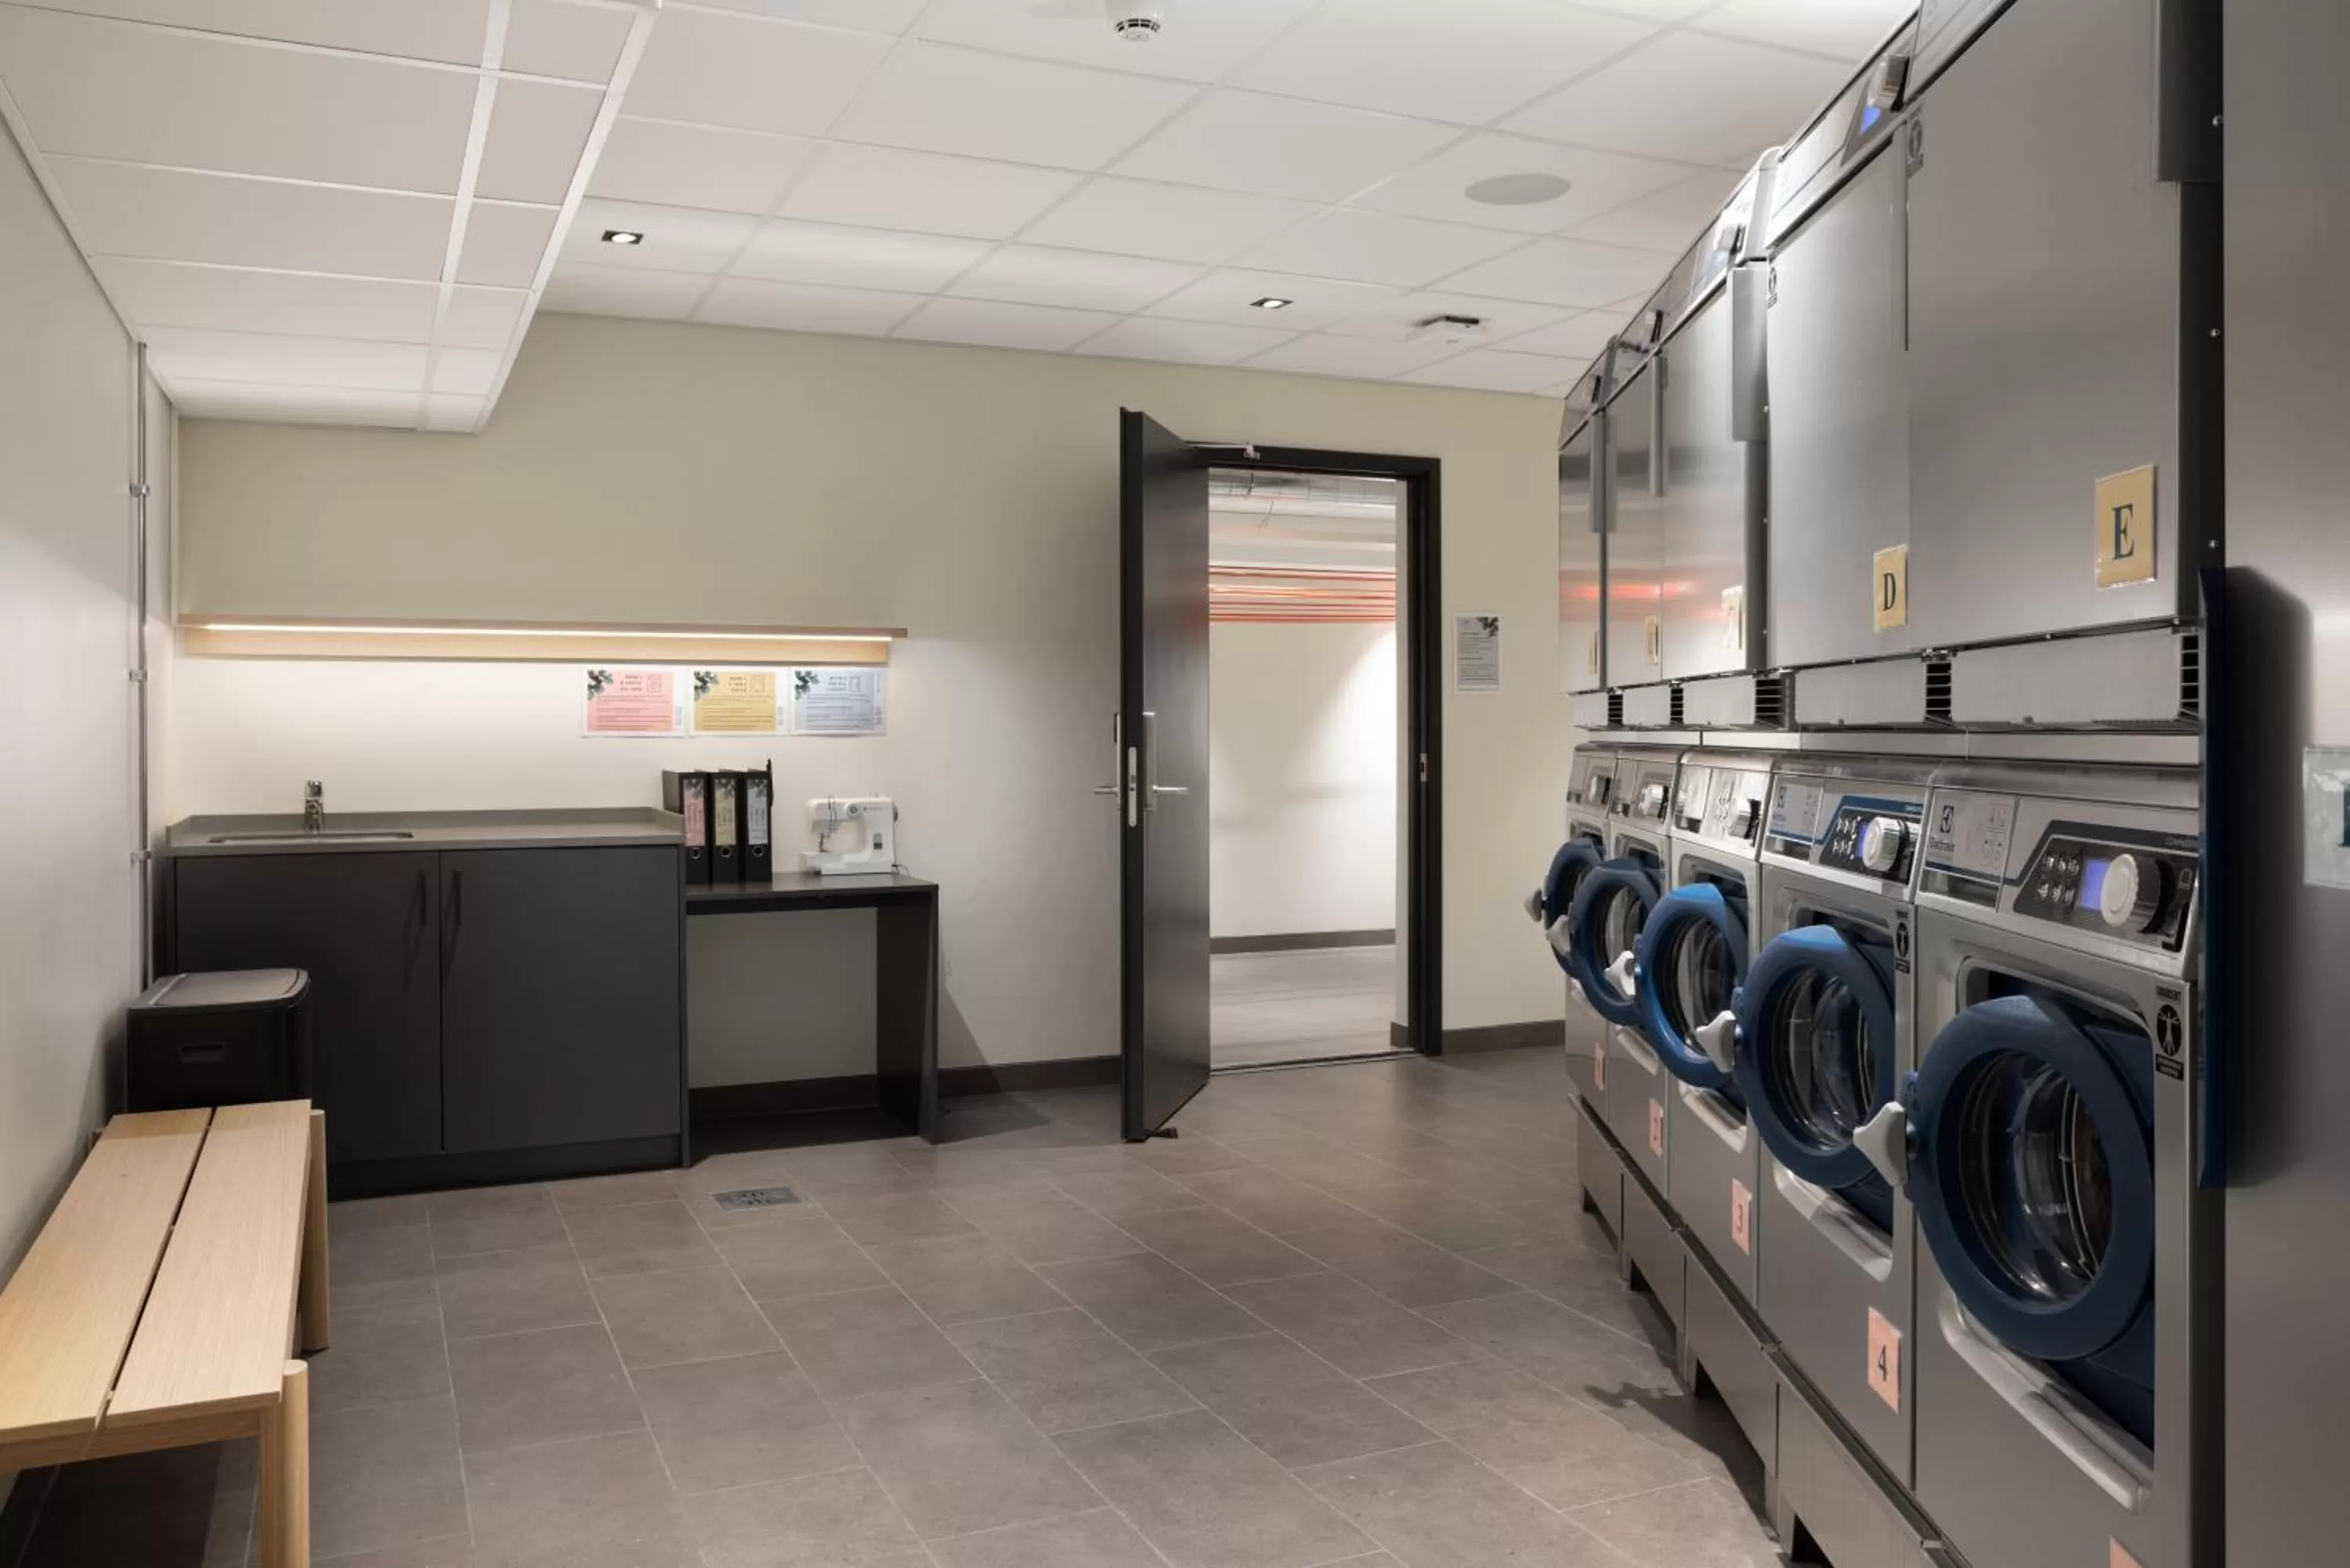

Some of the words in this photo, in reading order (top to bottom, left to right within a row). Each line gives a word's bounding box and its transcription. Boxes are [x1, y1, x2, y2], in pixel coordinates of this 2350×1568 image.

[2111, 502, 2135, 561] E
[1882, 572, 1896, 612] D
[1653, 1115, 1659, 1141] 2
[1737, 1201, 1744, 1234] 3
[1878, 1342, 1888, 1382] 4
